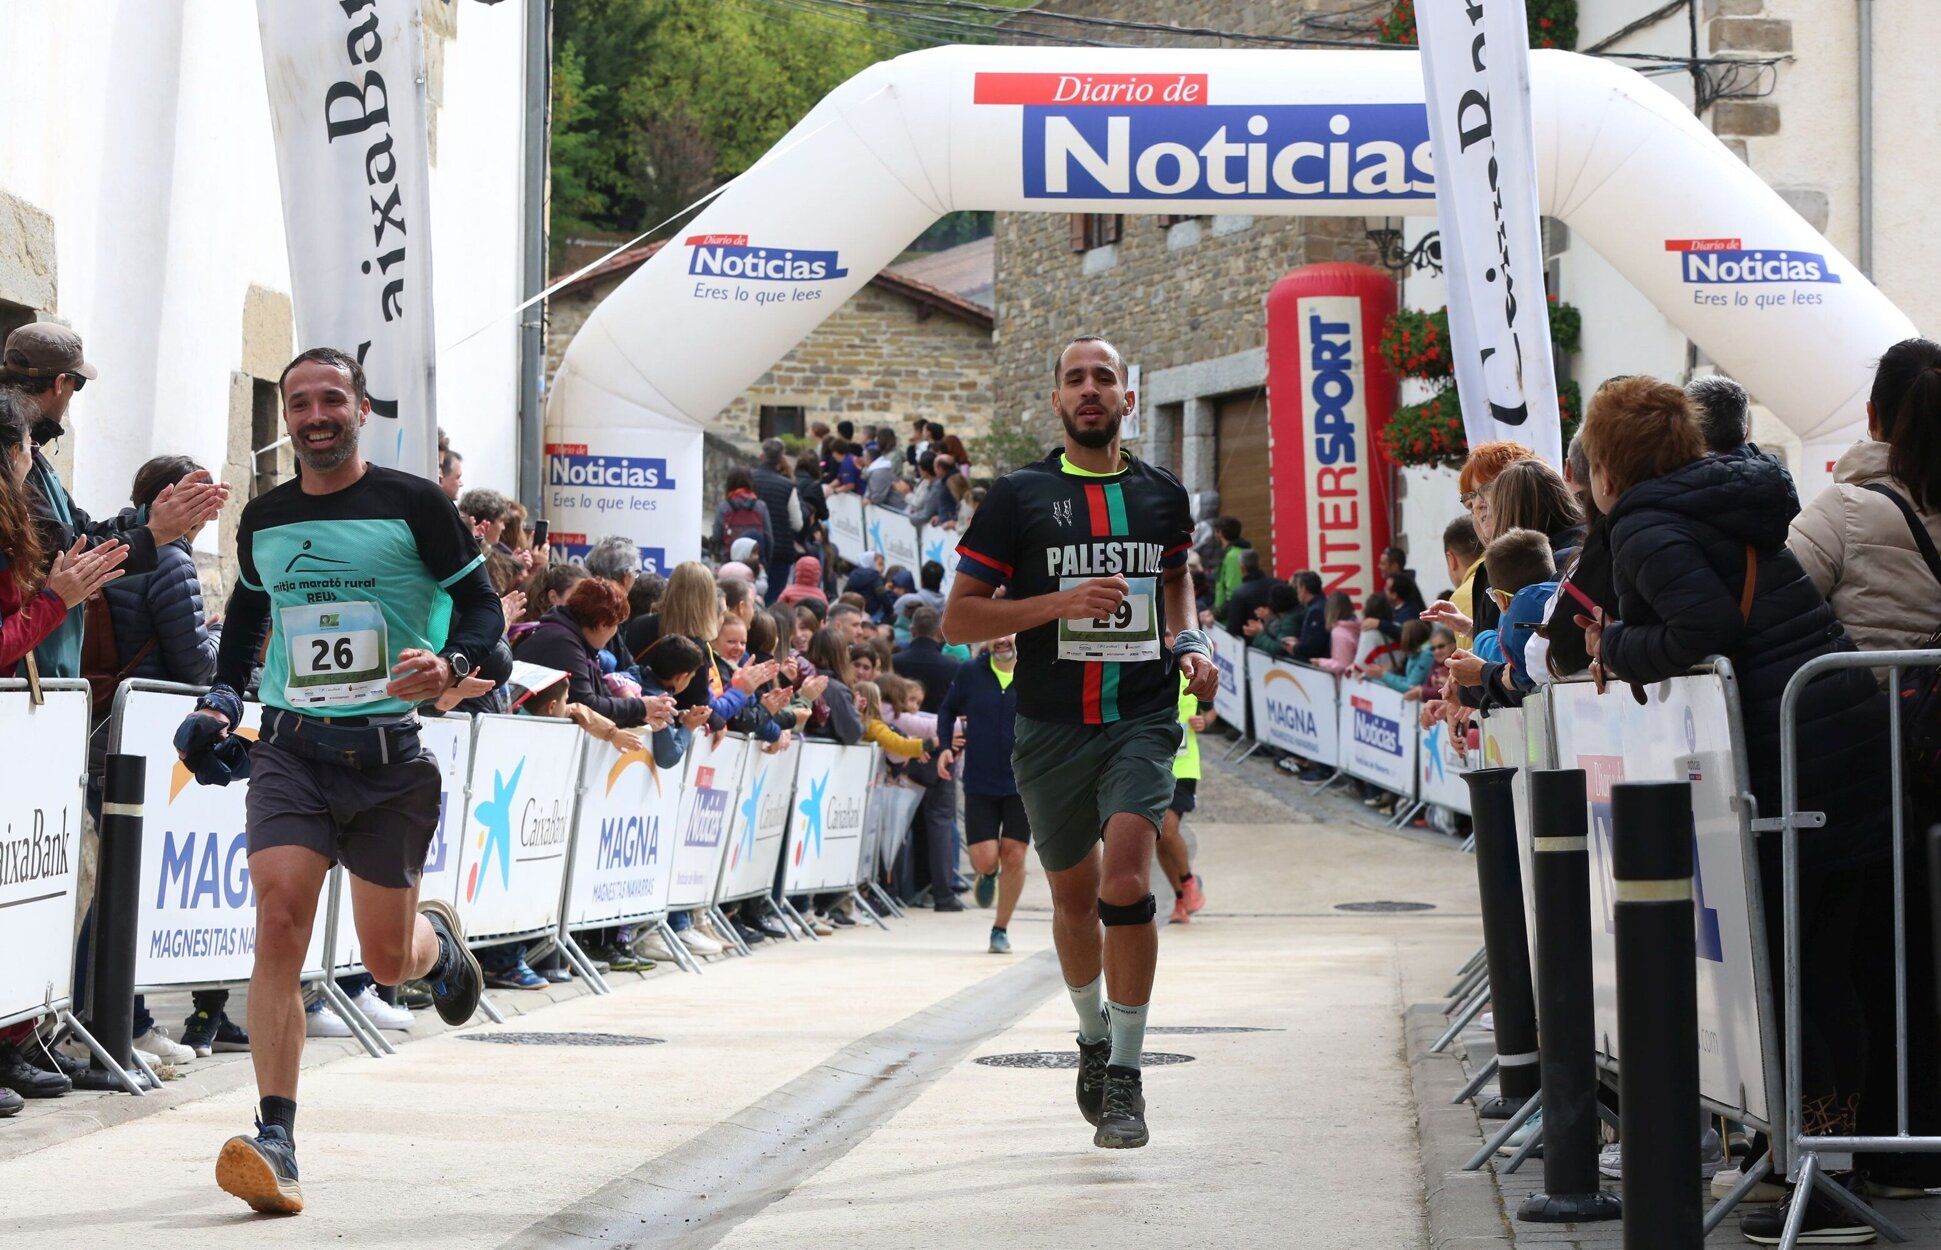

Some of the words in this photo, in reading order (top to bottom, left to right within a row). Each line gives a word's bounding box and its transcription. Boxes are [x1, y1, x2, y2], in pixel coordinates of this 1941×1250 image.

[1052, 75, 1154, 103] Diario
[1163, 76, 1200, 102] de
[703, 235, 733, 246] Diario
[734, 235, 746, 246] de
[1690, 240, 1725, 251] Diario
[1727, 240, 1740, 250] de
[694, 248, 827, 279] Noticias
[1688, 252, 1822, 282] Noticias
[694, 282, 728, 300] Eres
[735, 286, 749, 301] lo
[755, 290, 786, 306] que
[792, 287, 822, 301] lees
[1694, 290, 1728, 306] Eres
[1734, 290, 1748, 306] lo
[1755, 293, 1786, 310] que
[1792, 289, 1823, 305] lees
[552, 458, 658, 487] Noticias
[553, 491, 576, 508] Eres
[580, 493, 592, 508] lo
[597, 497, 624, 513] que
[629, 495, 657, 511] lees
[273, 582, 296, 593] mitja
[299, 578, 342, 589] marató
[345, 578, 376, 588] rural
[1092, 600, 1133, 629] 9
[311, 637, 354, 672] 26
[1266, 696, 1318, 738] MAGNA
[1355, 711, 1397, 752] Noticias
[520, 797, 570, 848] CaixaBank
[596, 815, 659, 871] MAGNA
[156, 831, 257, 910] MAG
[149, 928, 237, 959] MAGNESITAS
